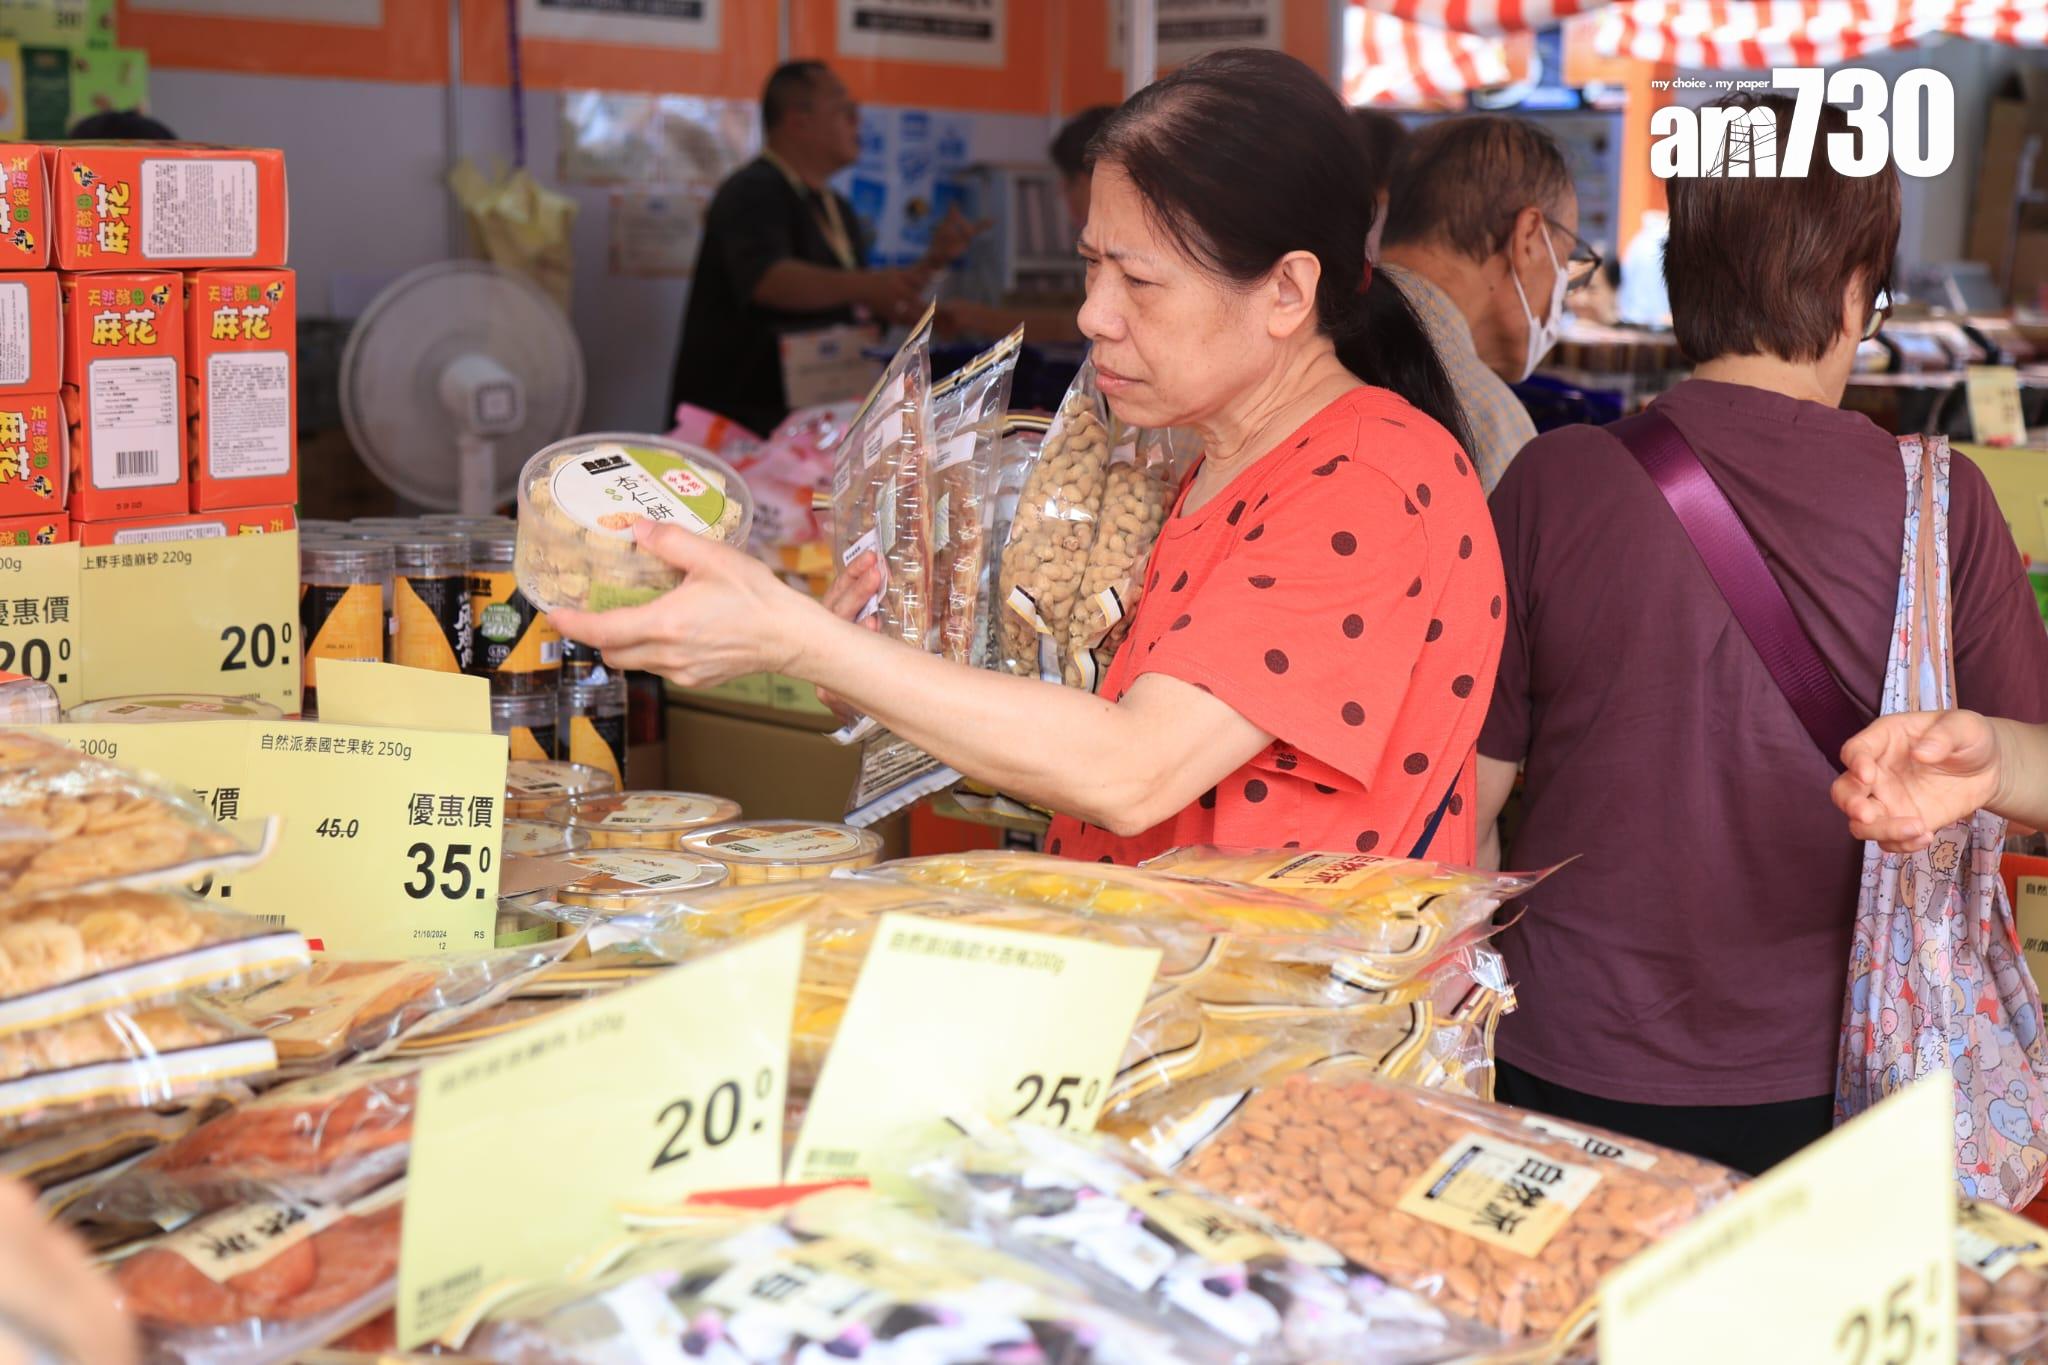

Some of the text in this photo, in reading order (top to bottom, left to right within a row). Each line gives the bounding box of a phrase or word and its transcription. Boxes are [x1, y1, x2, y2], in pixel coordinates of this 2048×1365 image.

[95, 181, 131, 255] 麻花
[91, 308, 158, 346] 麻花
[210, 305, 272, 341] 麻花
[615, 475, 675, 521] 杏仁餅
[162, 551, 192, 566] 220g
[261, 733, 412, 761] 自然派泰國芒果乾 250g
[407, 793, 494, 829] 優惠價
[316, 818, 359, 839] 45.0
[413, 929, 486, 939] 21/10/2024 RS
[438, 942, 447, 950] 12
